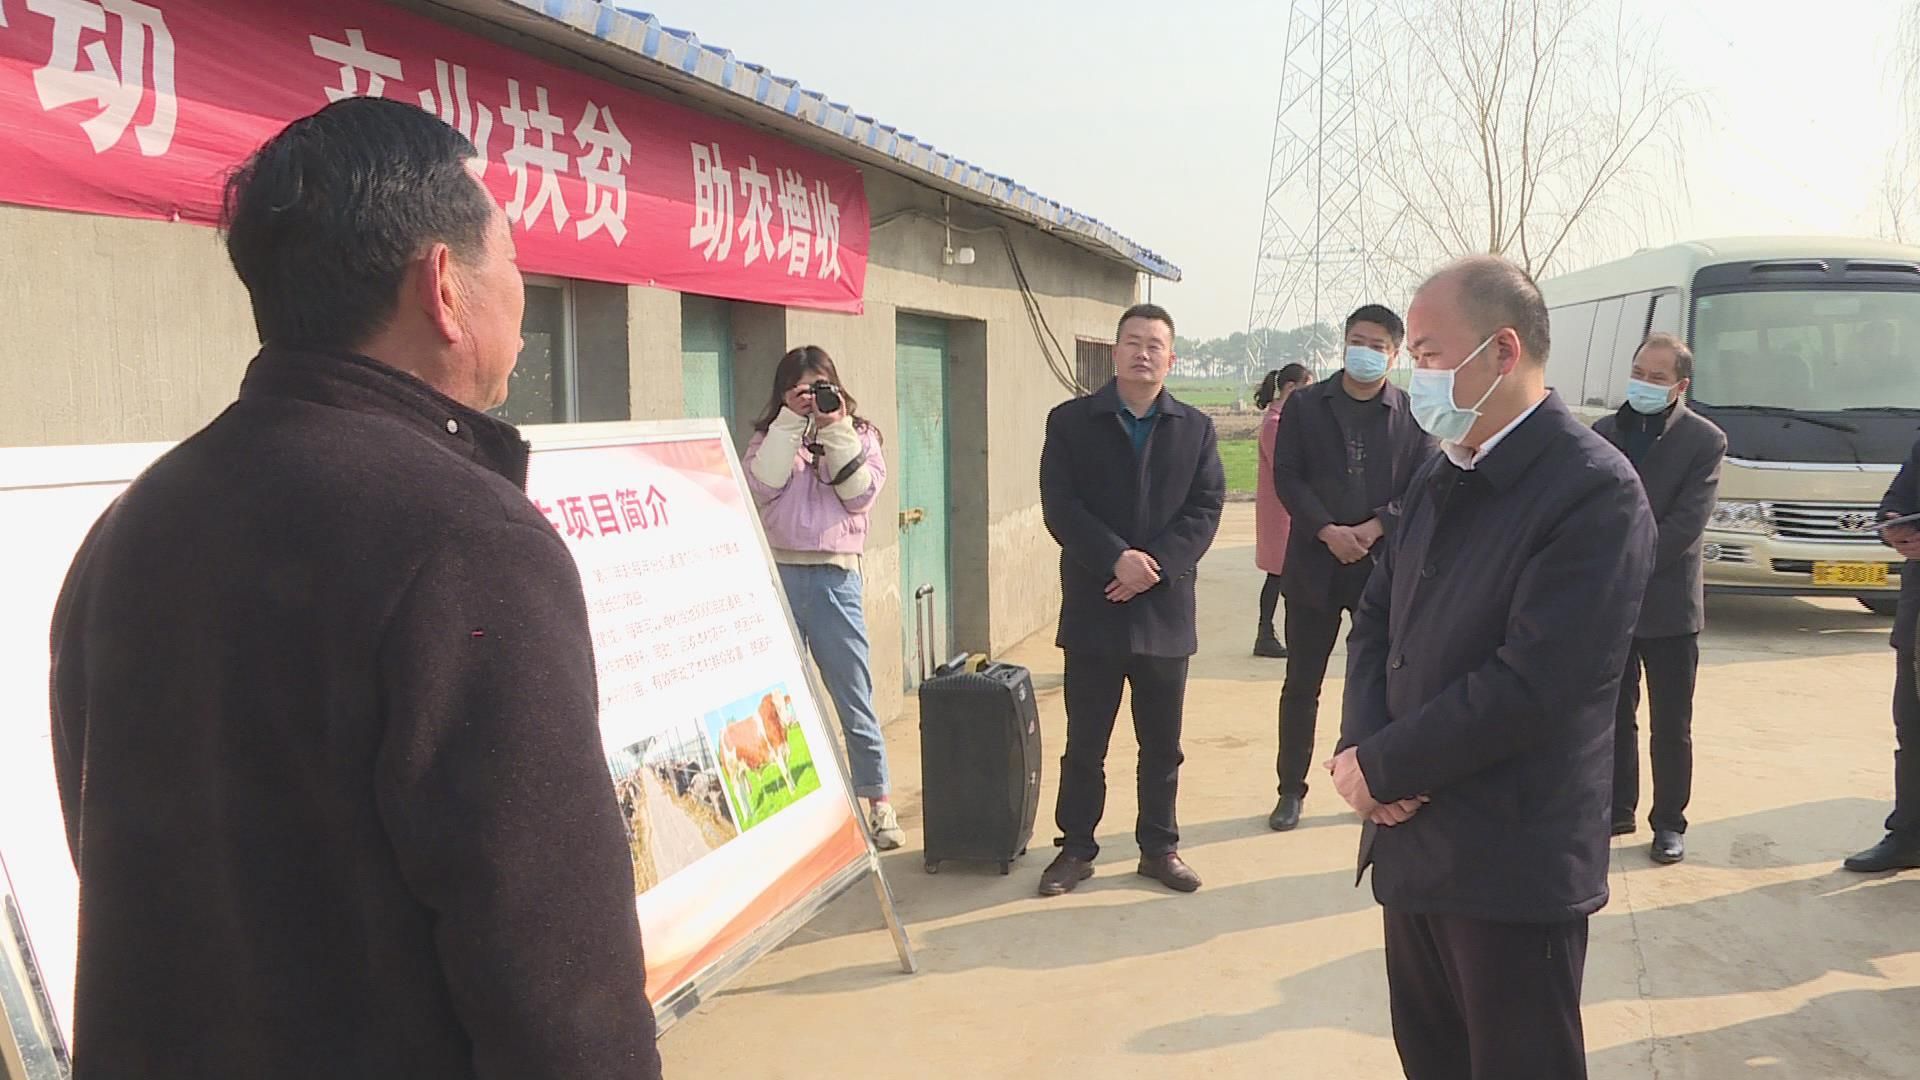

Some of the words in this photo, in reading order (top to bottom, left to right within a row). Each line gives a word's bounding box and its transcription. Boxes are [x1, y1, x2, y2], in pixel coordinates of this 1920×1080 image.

[0, 0, 178, 157] 动
[309, 28, 632, 247] 产业扶贫
[689, 141, 841, 281] 助农增收
